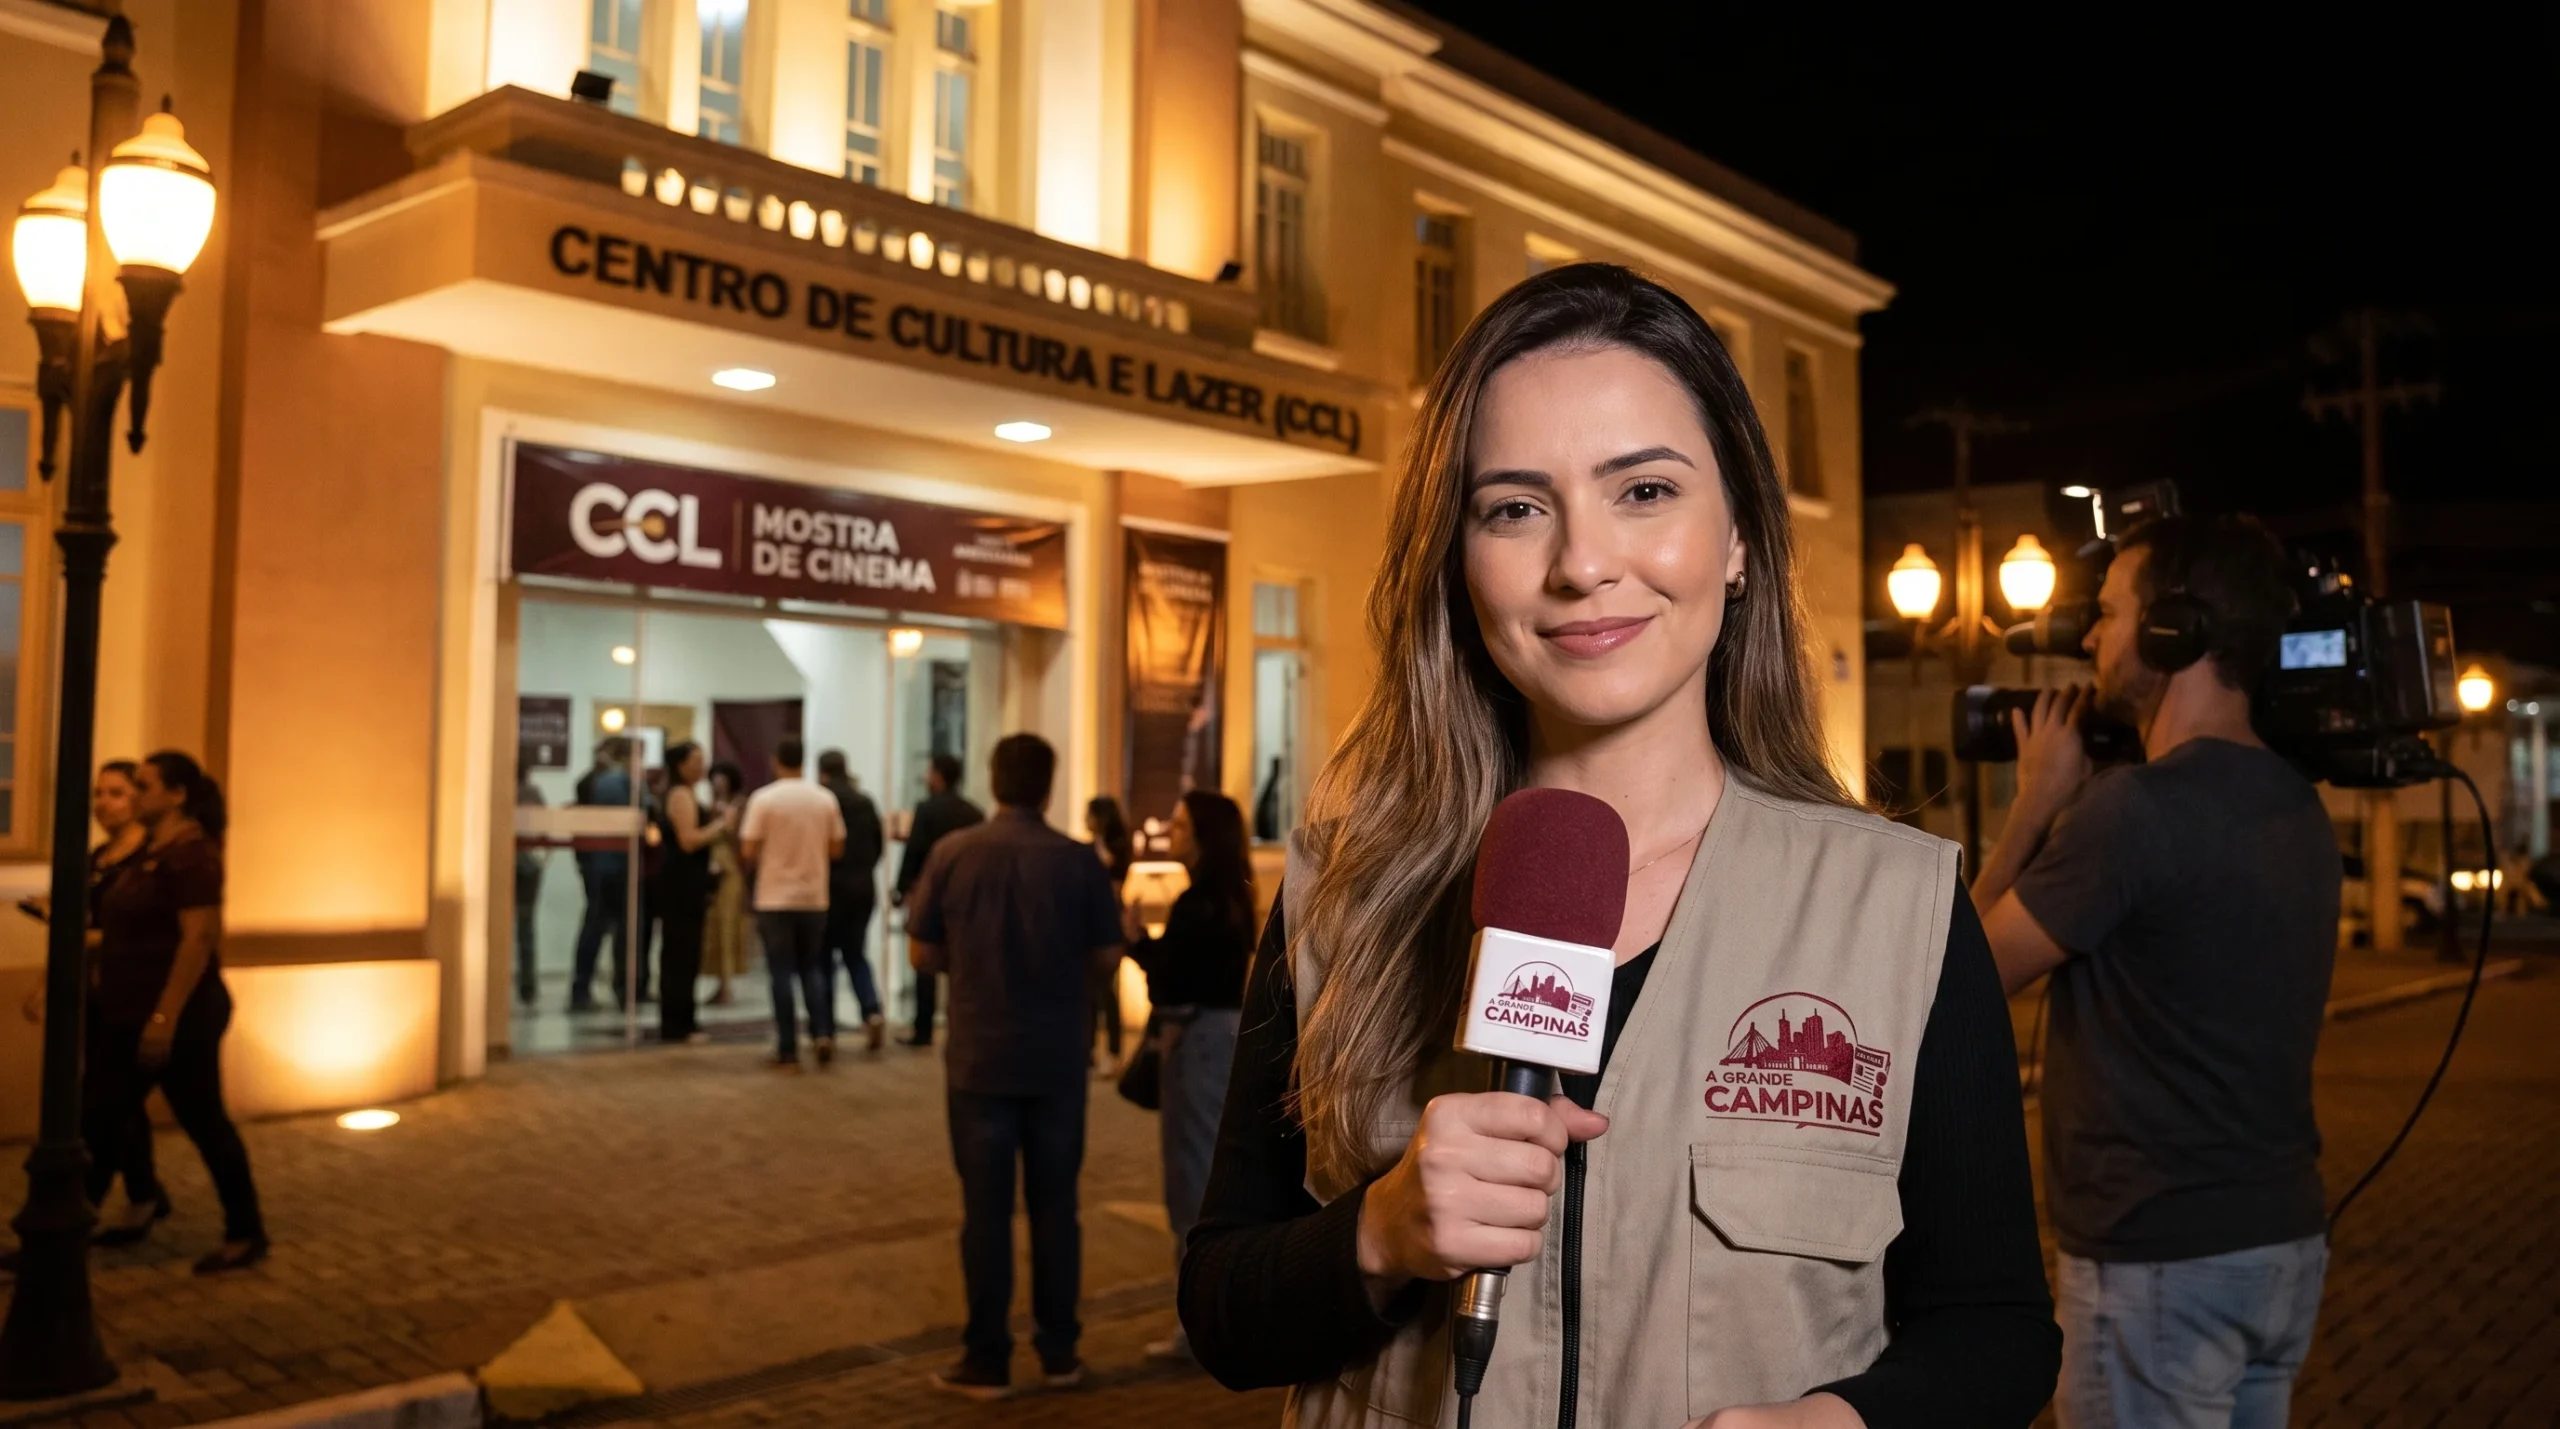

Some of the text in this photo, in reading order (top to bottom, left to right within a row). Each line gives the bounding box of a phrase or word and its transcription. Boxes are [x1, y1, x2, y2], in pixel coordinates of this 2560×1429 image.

[550, 225, 1360, 453] CENTRO DE CULTURA E LAZER (CCL)
[569, 481, 722, 570] CCL
[752, 502, 900, 555] MOSTRA
[752, 541, 800, 578] DE
[806, 548, 937, 594] CINEMA
[1484, 1006, 1590, 1037] CAMPINAS
[1498, 1000, 1534, 1012] GRANDE
[1705, 1070, 1793, 1086] A GRANDE
[1704, 1085, 1884, 1129] CAMPINAS
